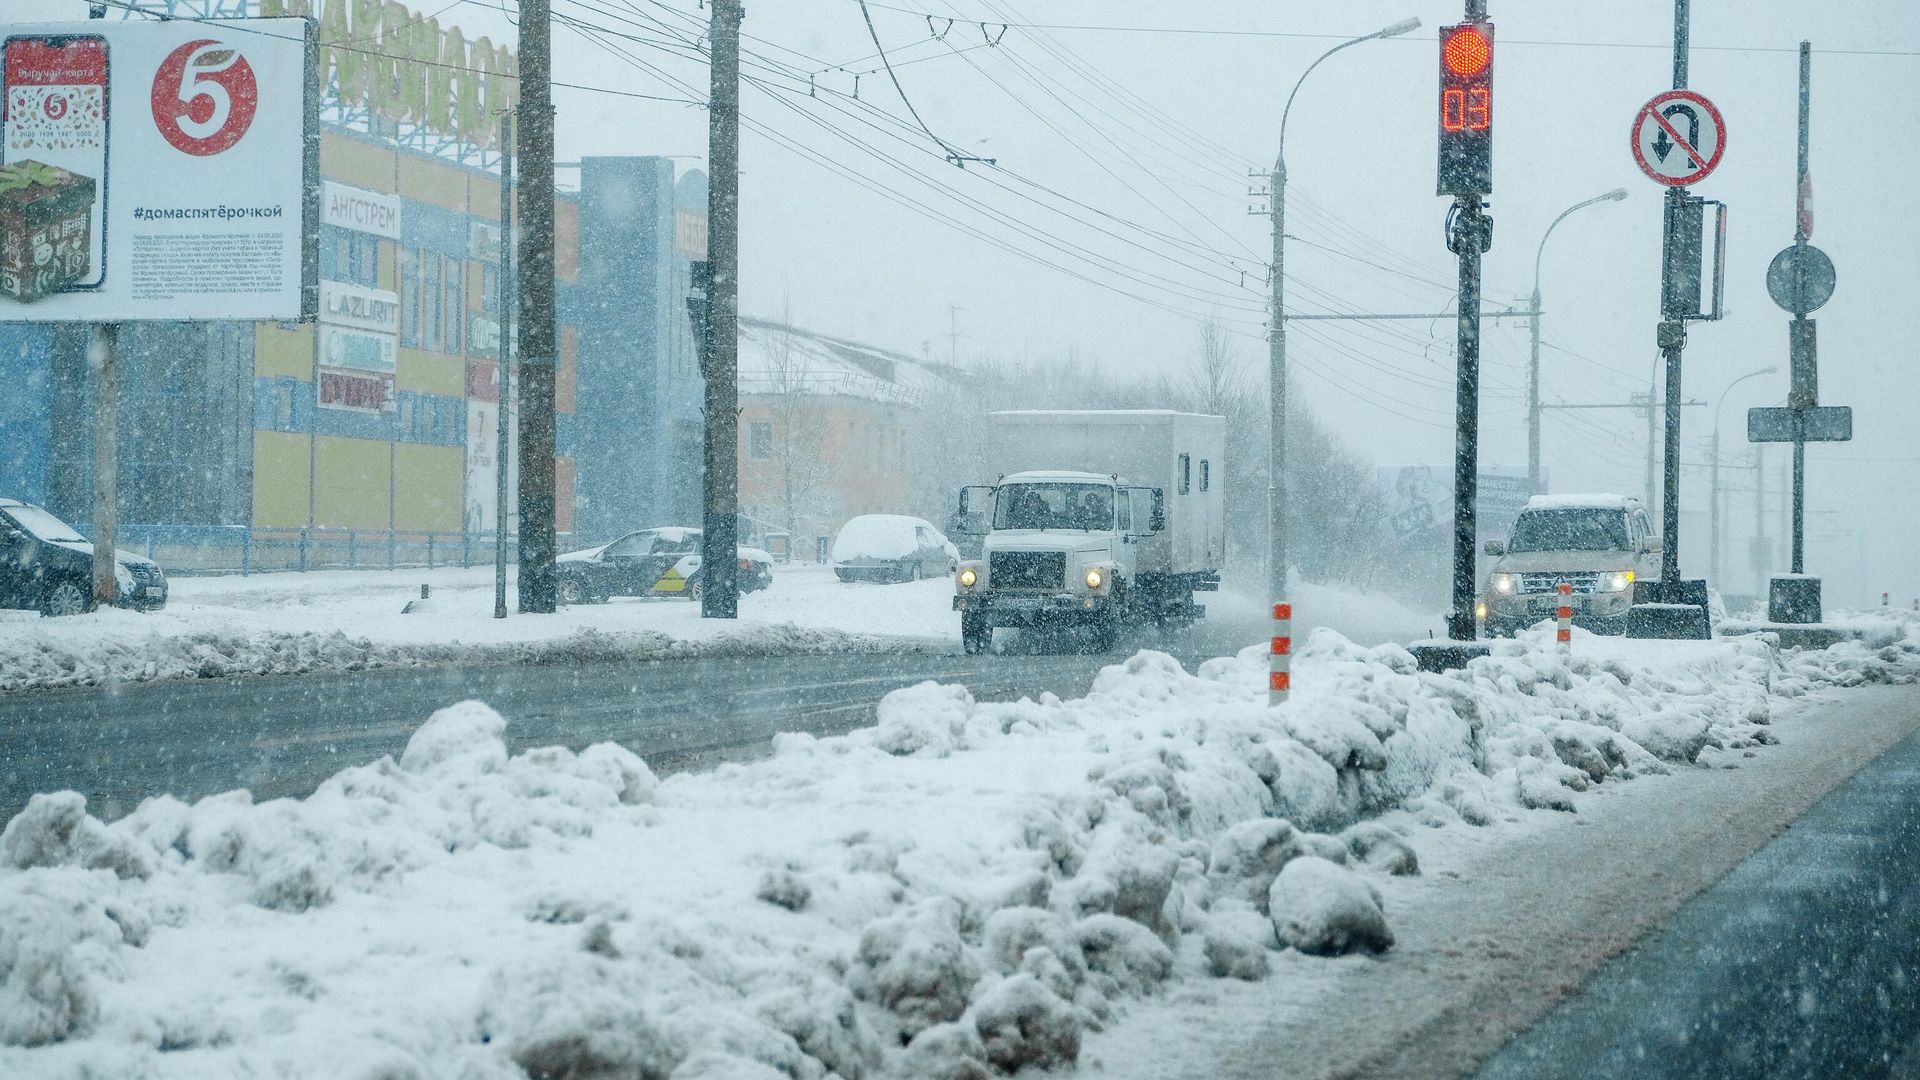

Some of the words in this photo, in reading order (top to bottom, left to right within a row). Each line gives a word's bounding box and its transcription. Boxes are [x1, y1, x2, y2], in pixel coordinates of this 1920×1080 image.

[1443, 88, 1489, 129] 03
[134, 204, 282, 221] #домаспятёрочкой
[330, 194, 395, 230] АНГСТРЕМ
[327, 291, 397, 323] LAZURIT
